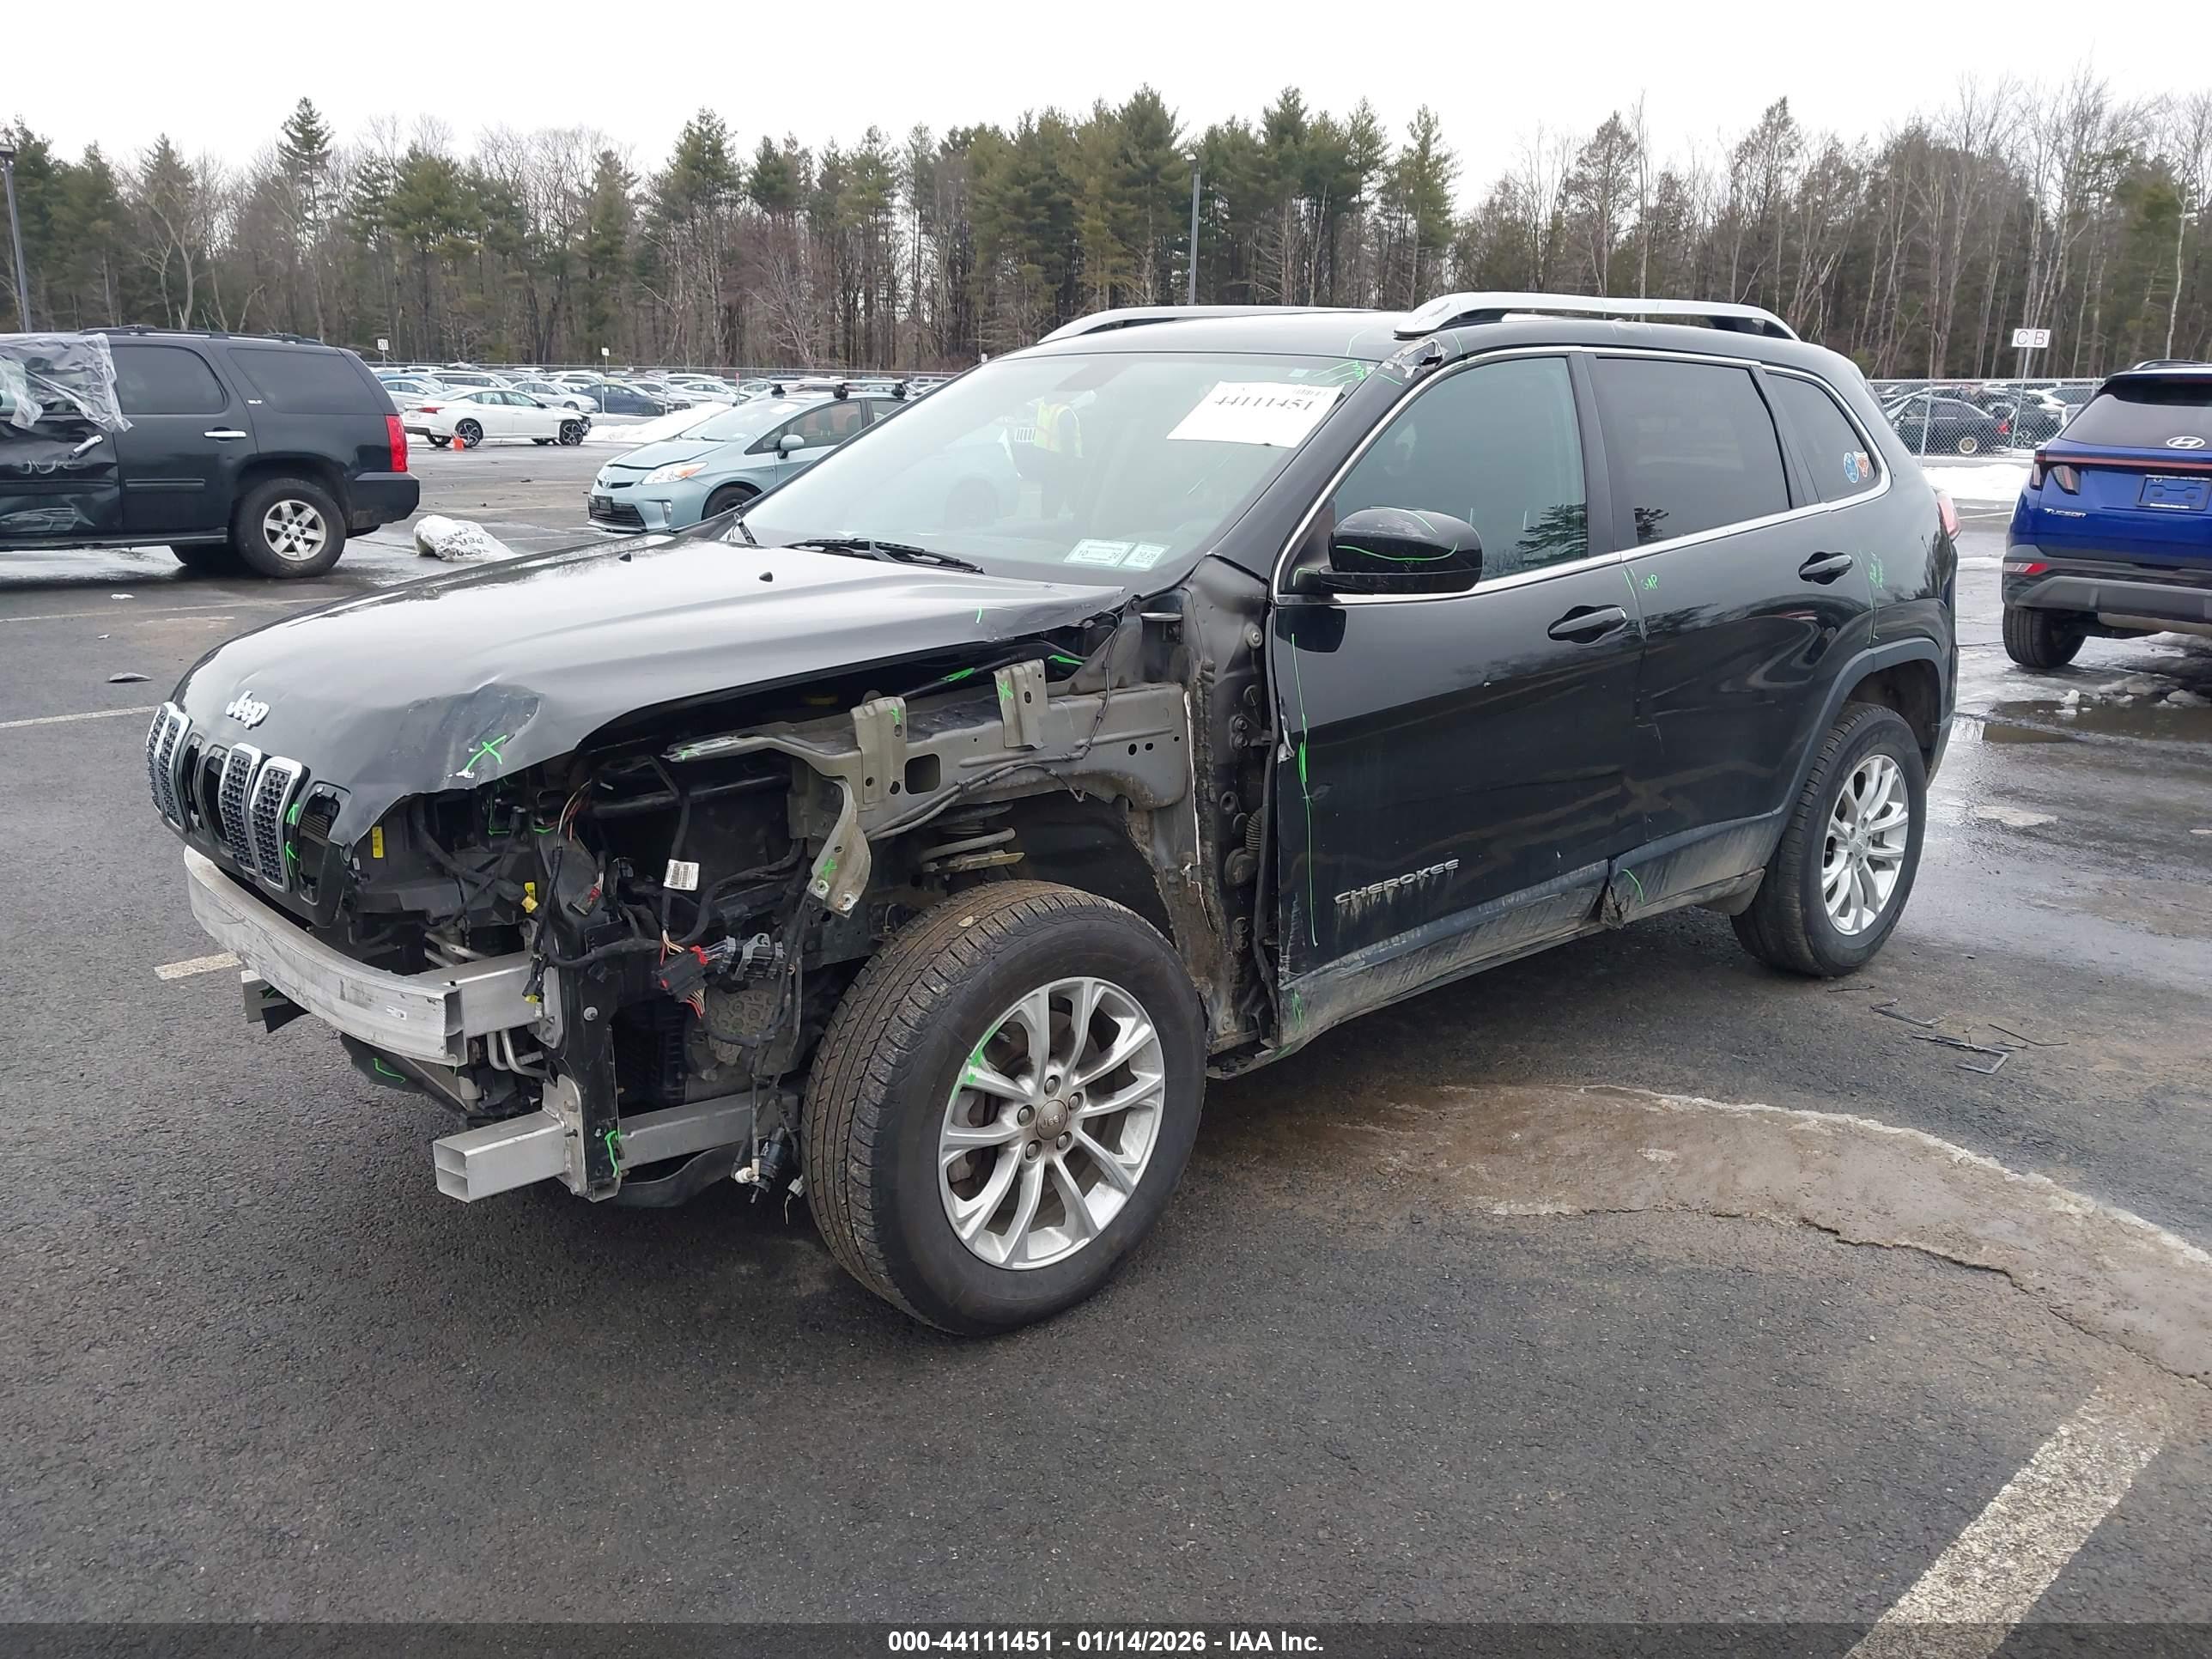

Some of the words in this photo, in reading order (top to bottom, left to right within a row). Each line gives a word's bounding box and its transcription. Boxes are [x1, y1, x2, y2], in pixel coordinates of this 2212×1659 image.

[2016, 330, 2029, 345] C
[2033, 331, 2046, 346] B
[1214, 395, 1315, 411] 44111451
[225, 689, 270, 731] Jeep
[1334, 858, 1460, 905] CHEROKEE
[1040, 1113, 1065, 1129] Jeep
